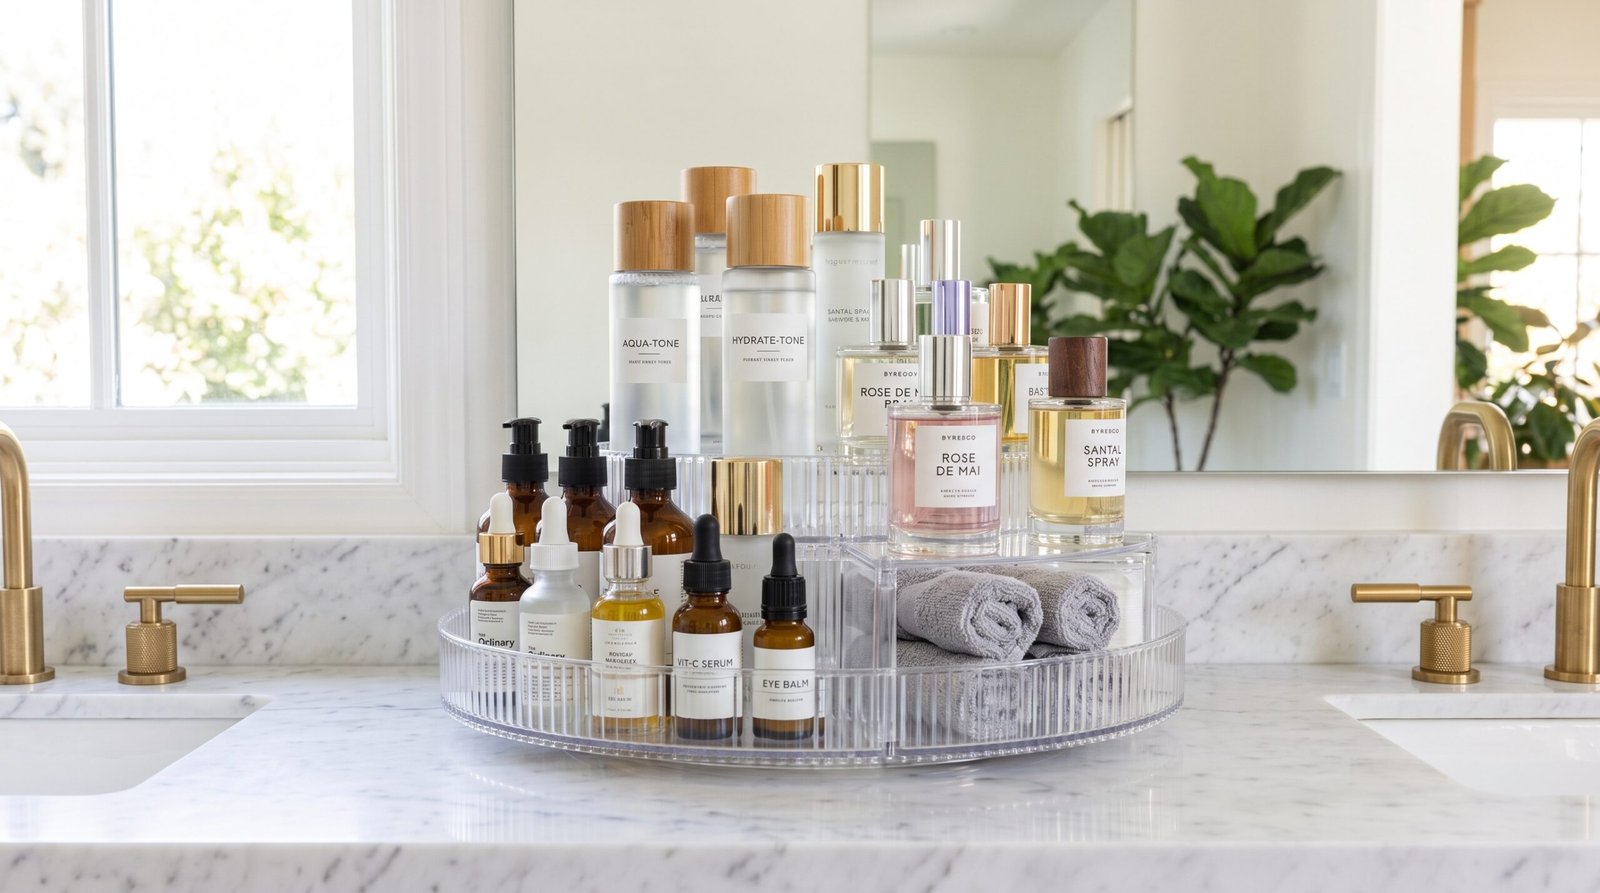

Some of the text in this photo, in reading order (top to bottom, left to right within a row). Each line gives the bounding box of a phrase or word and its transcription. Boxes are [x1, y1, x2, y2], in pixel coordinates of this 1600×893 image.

[622, 339, 680, 348] AQUA-TONE
[732, 336, 805, 345] HYDRATE-TONE
[860, 387, 891, 397] ROSE
[895, 387, 911, 397] DE
[1084, 445, 1122, 455] SANTAL
[942, 453, 976, 463] ROSE
[1087, 457, 1120, 467] SPRAY
[936, 466, 980, 476] DE MAI
[677, 658, 733, 669] VIT-C SERUM
[762, 679, 809, 689] EYE BALM
